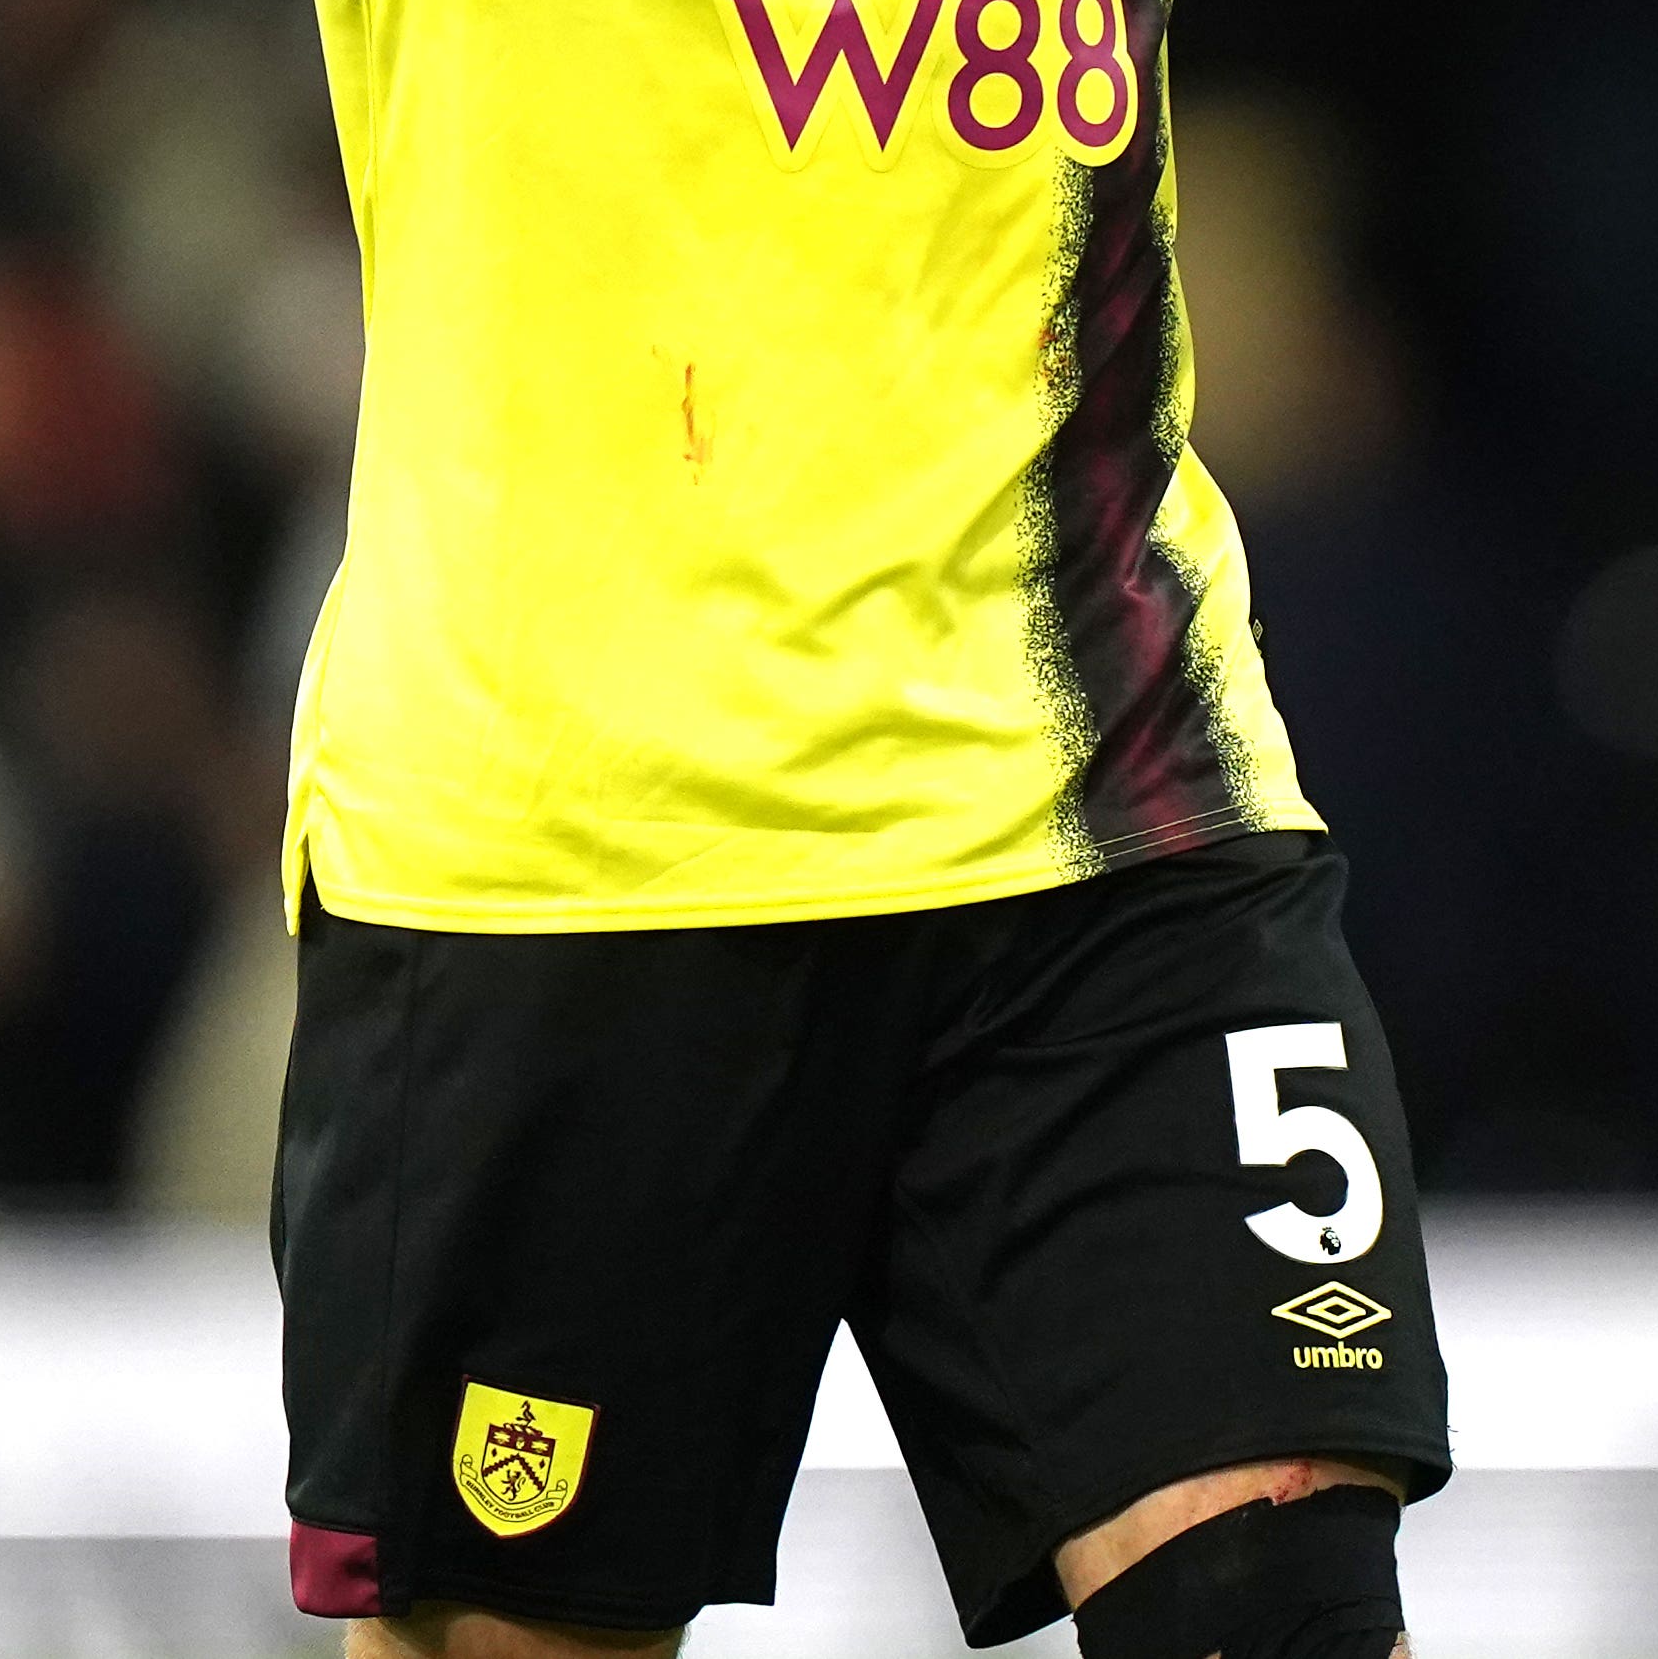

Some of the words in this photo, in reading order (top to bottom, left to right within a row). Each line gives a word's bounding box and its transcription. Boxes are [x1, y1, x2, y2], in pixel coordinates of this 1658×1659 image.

[1224, 1021, 1384, 1265] 5
[1293, 1342, 1383, 1370] umbro
[494, 1507, 534, 1519] FOOTBALL
[534, 1501, 555, 1512] CLUB
